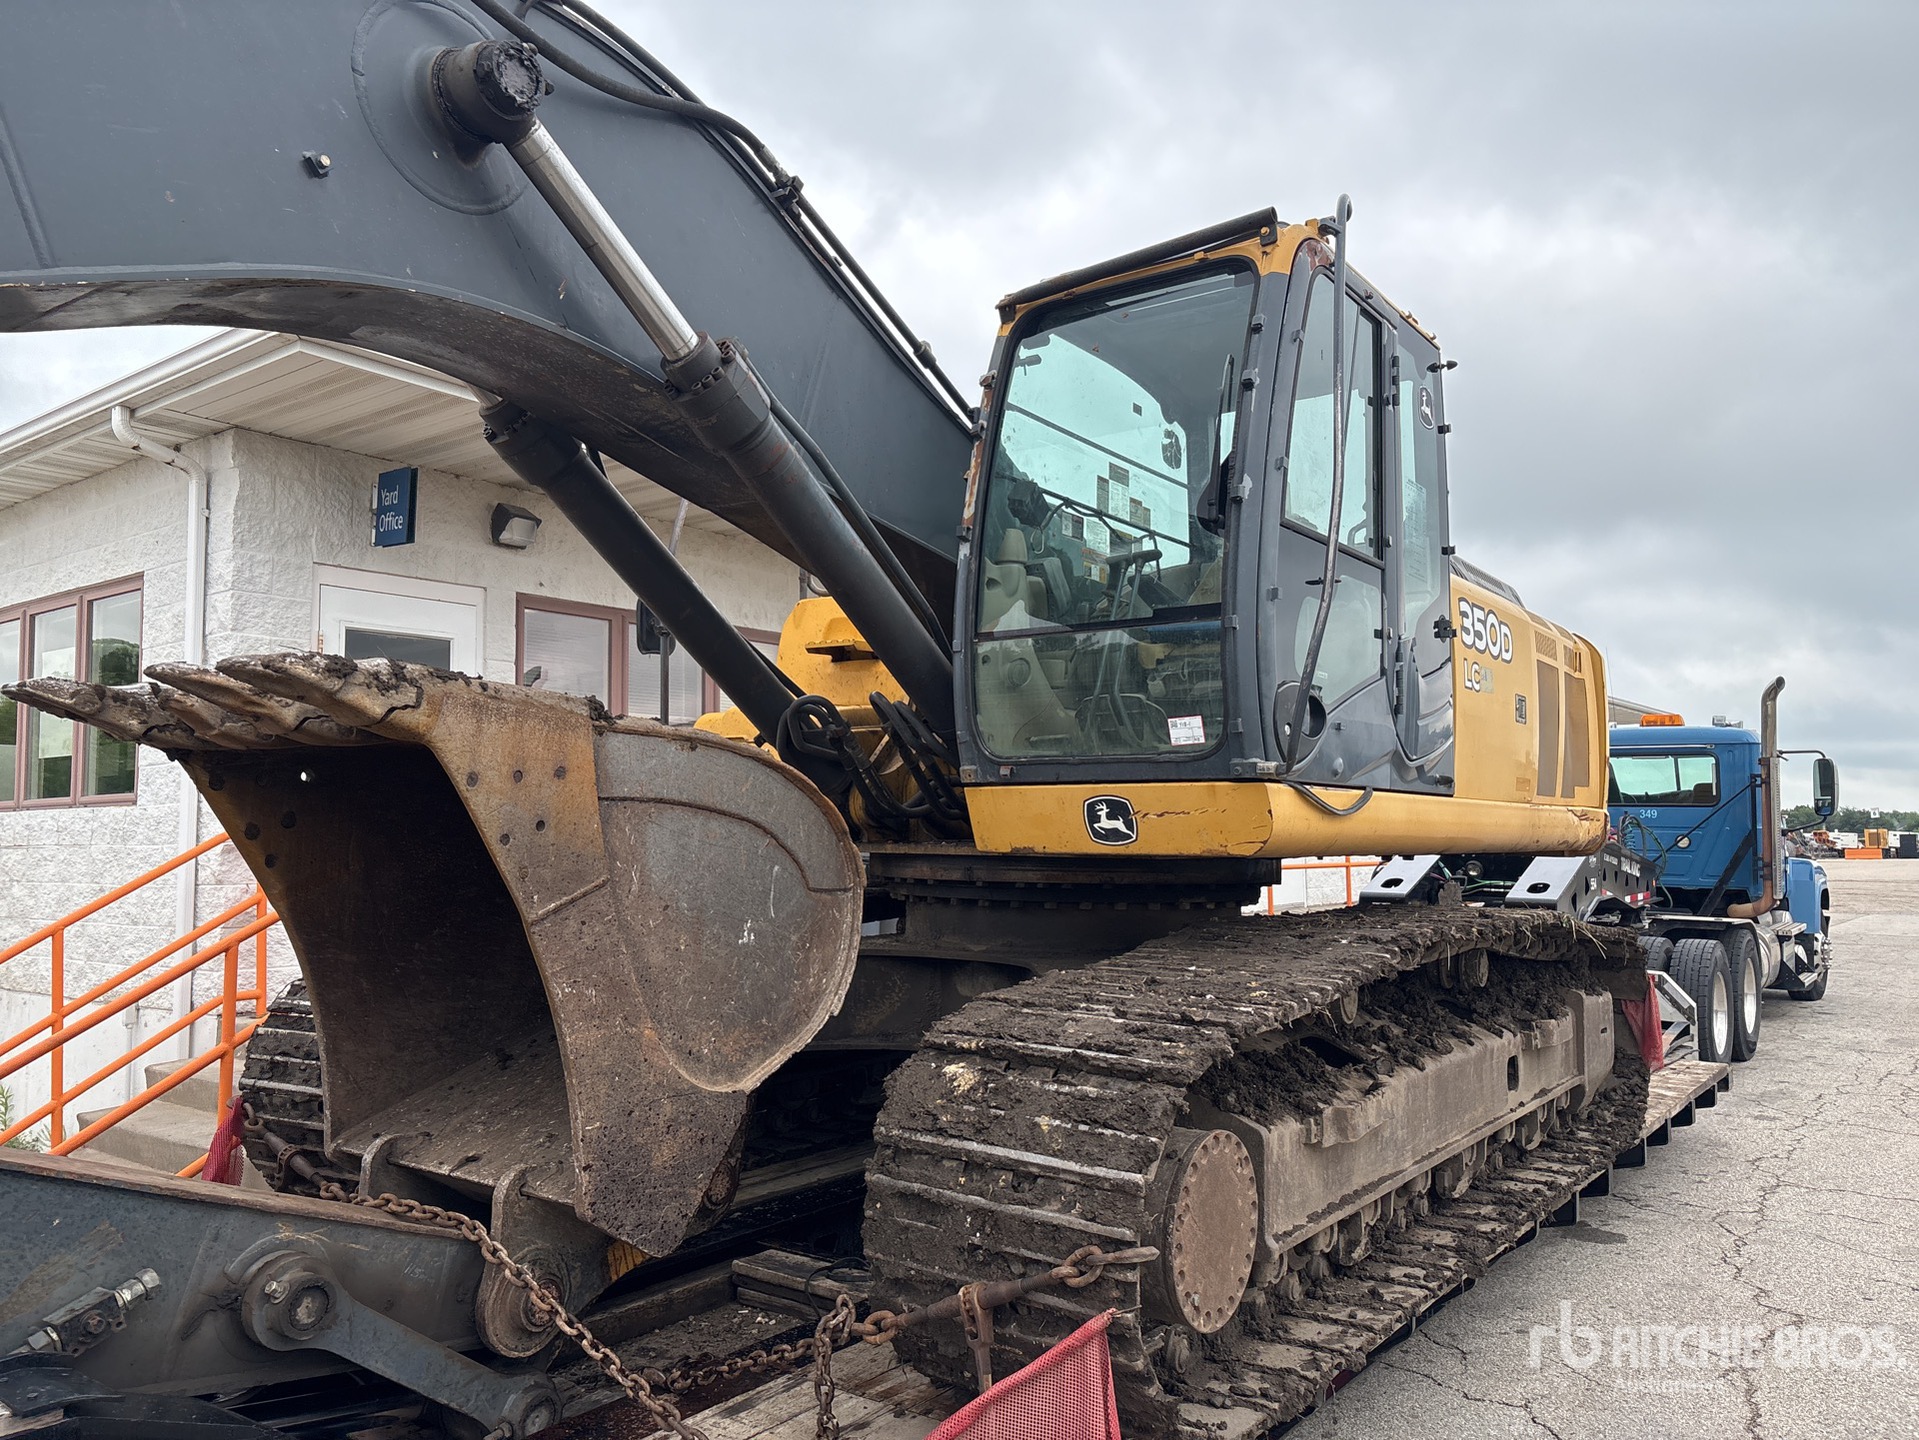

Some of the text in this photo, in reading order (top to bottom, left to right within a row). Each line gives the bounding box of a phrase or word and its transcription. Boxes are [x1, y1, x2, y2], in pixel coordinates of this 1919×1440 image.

[381, 485, 399, 506] Yard
[379, 512, 403, 532] Office
[1458, 597, 1513, 664] 350D
[1640, 809, 1657, 818] 349
